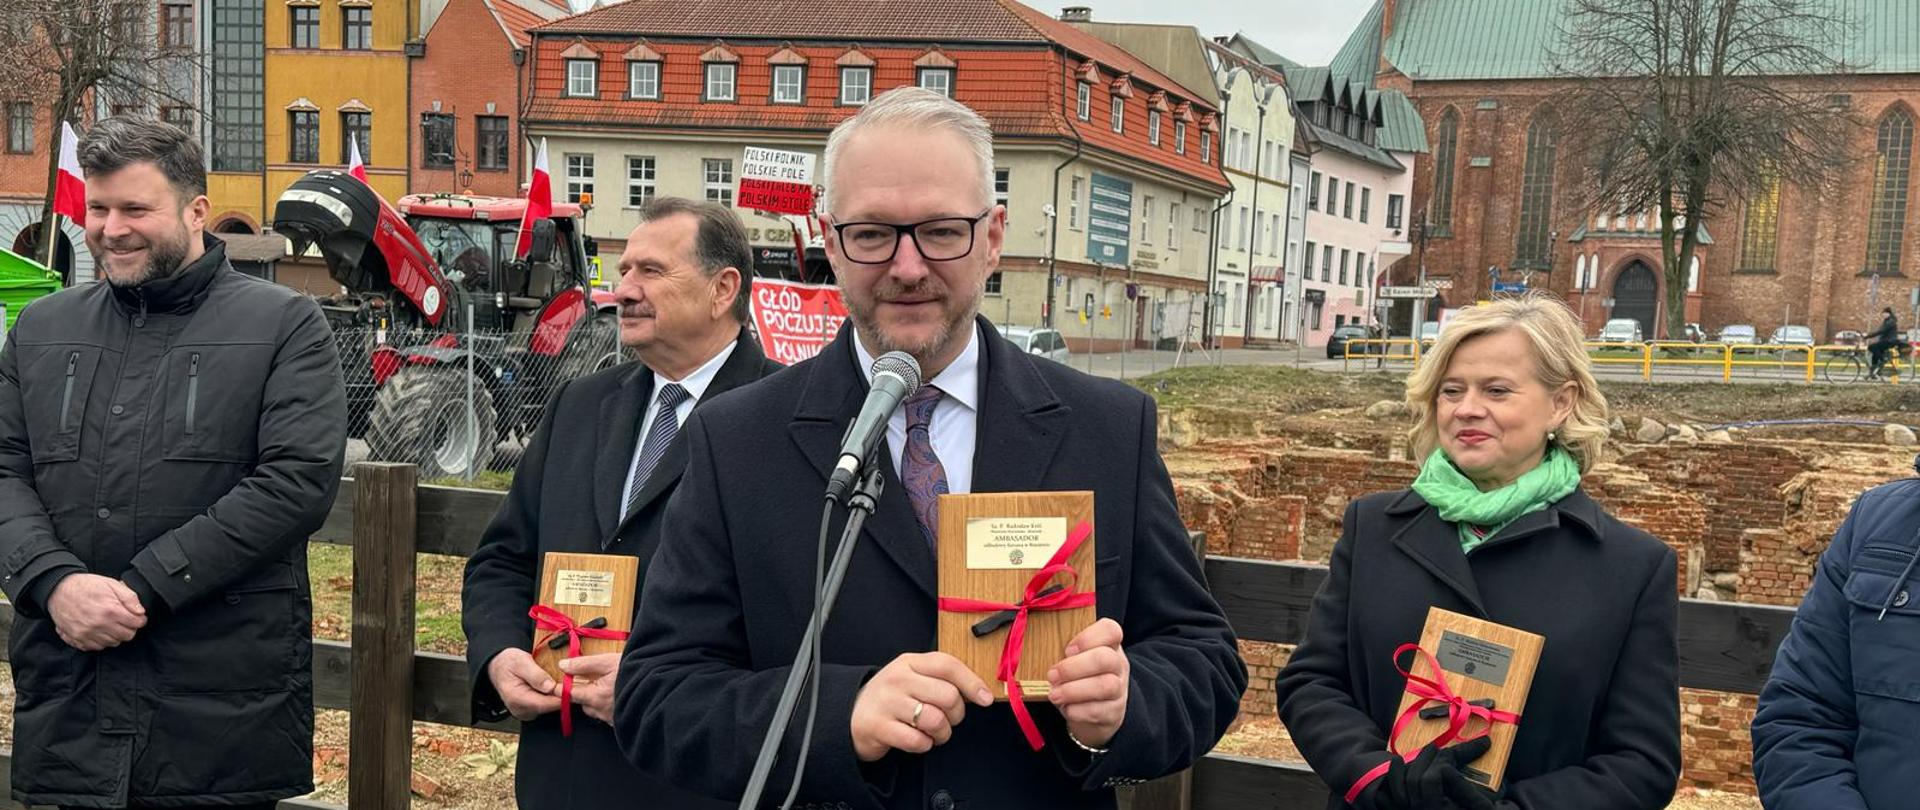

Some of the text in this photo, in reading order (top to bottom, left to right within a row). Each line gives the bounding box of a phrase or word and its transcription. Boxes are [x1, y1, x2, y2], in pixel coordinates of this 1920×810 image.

[745, 148, 806, 166] POLSKI ROLNIK
[743, 162, 805, 180] POLSKIE POLE
[740, 192, 779, 207] POLSKIM
[758, 286, 802, 312] GŁÓD
